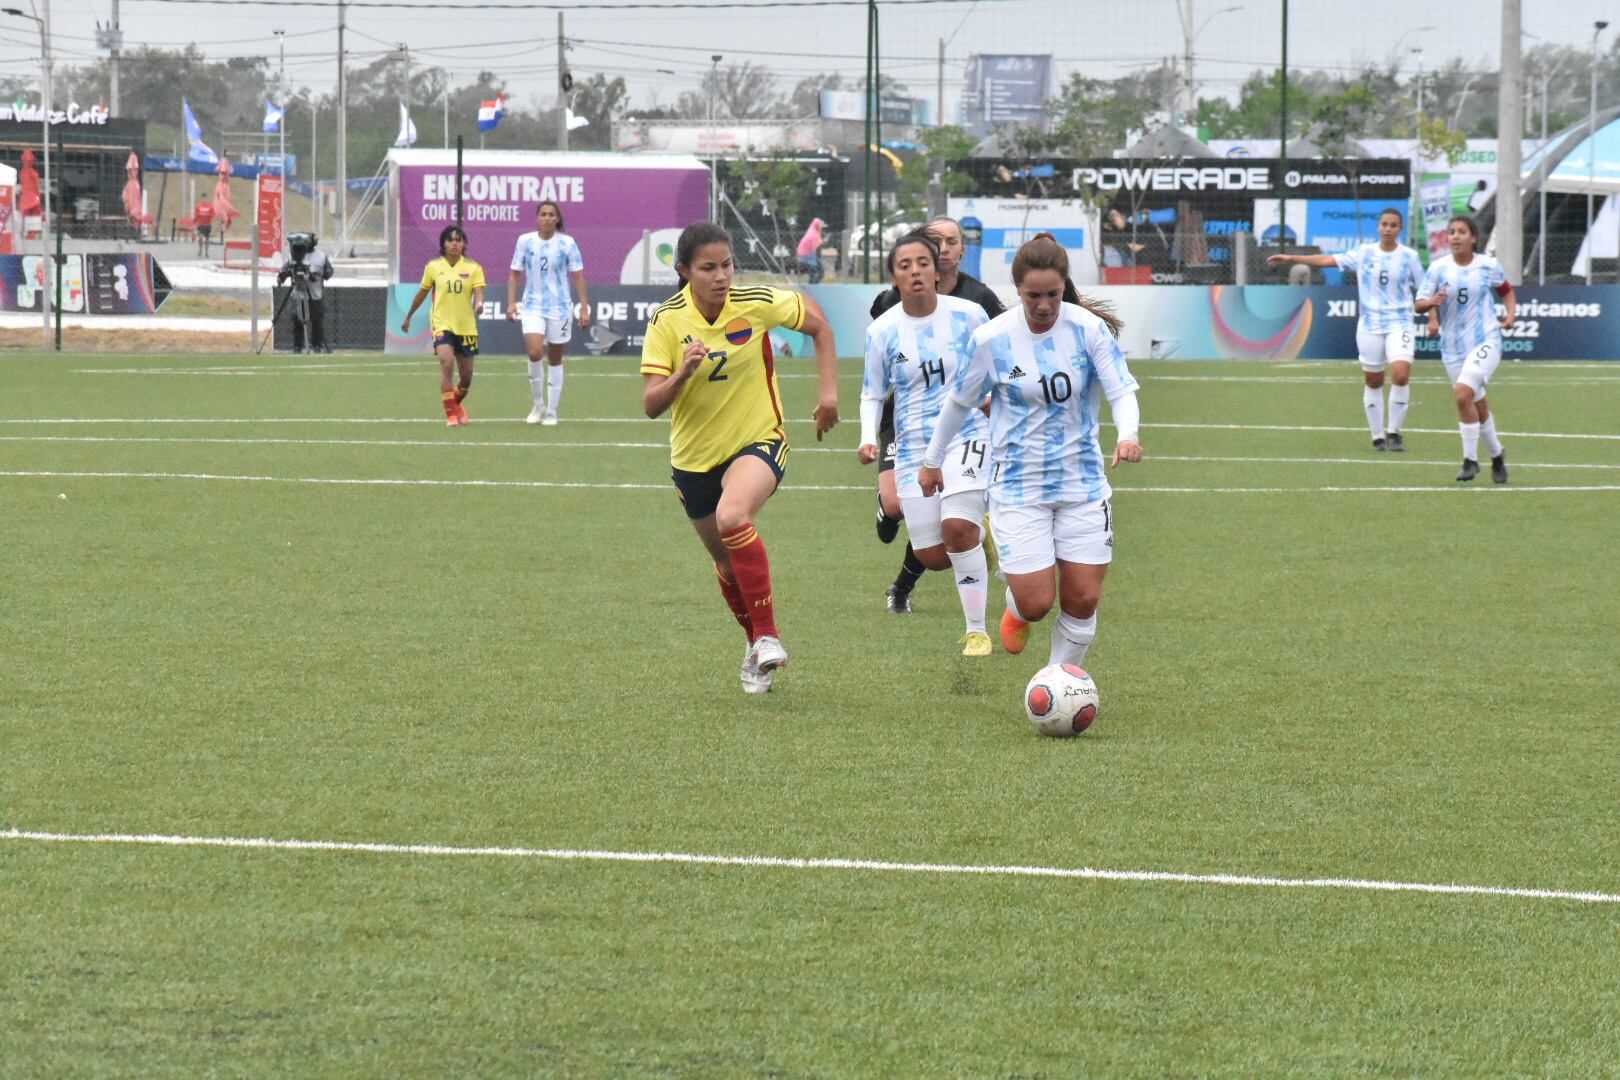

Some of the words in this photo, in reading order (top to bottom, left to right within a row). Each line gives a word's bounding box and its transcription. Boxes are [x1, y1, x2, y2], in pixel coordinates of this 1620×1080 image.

[1073, 168, 1269, 190] POWERADE
[1303, 174, 1347, 184] PAUSA
[1360, 174, 1405, 184] POWER
[423, 174, 584, 202] ENCONTRATE
[422, 204, 447, 220] CON
[467, 205, 520, 221] DEPORTE
[1425, 204, 1448, 217] MIX
[540, 257, 549, 272] 2
[446, 279, 463, 294] 10
[1379, 270, 1389, 286] 6
[1456, 287, 1469, 305] 5
[479, 302, 507, 320] EL
[597, 302, 628, 321] DE
[1327, 300, 1356, 317] XII
[1401, 331, 1411, 344] 6
[1476, 344, 1492, 360] 5
[708, 351, 728, 382] 2
[918, 356, 945, 389] 14
[1037, 371, 1072, 405] 10
[961, 439, 986, 469] 14
